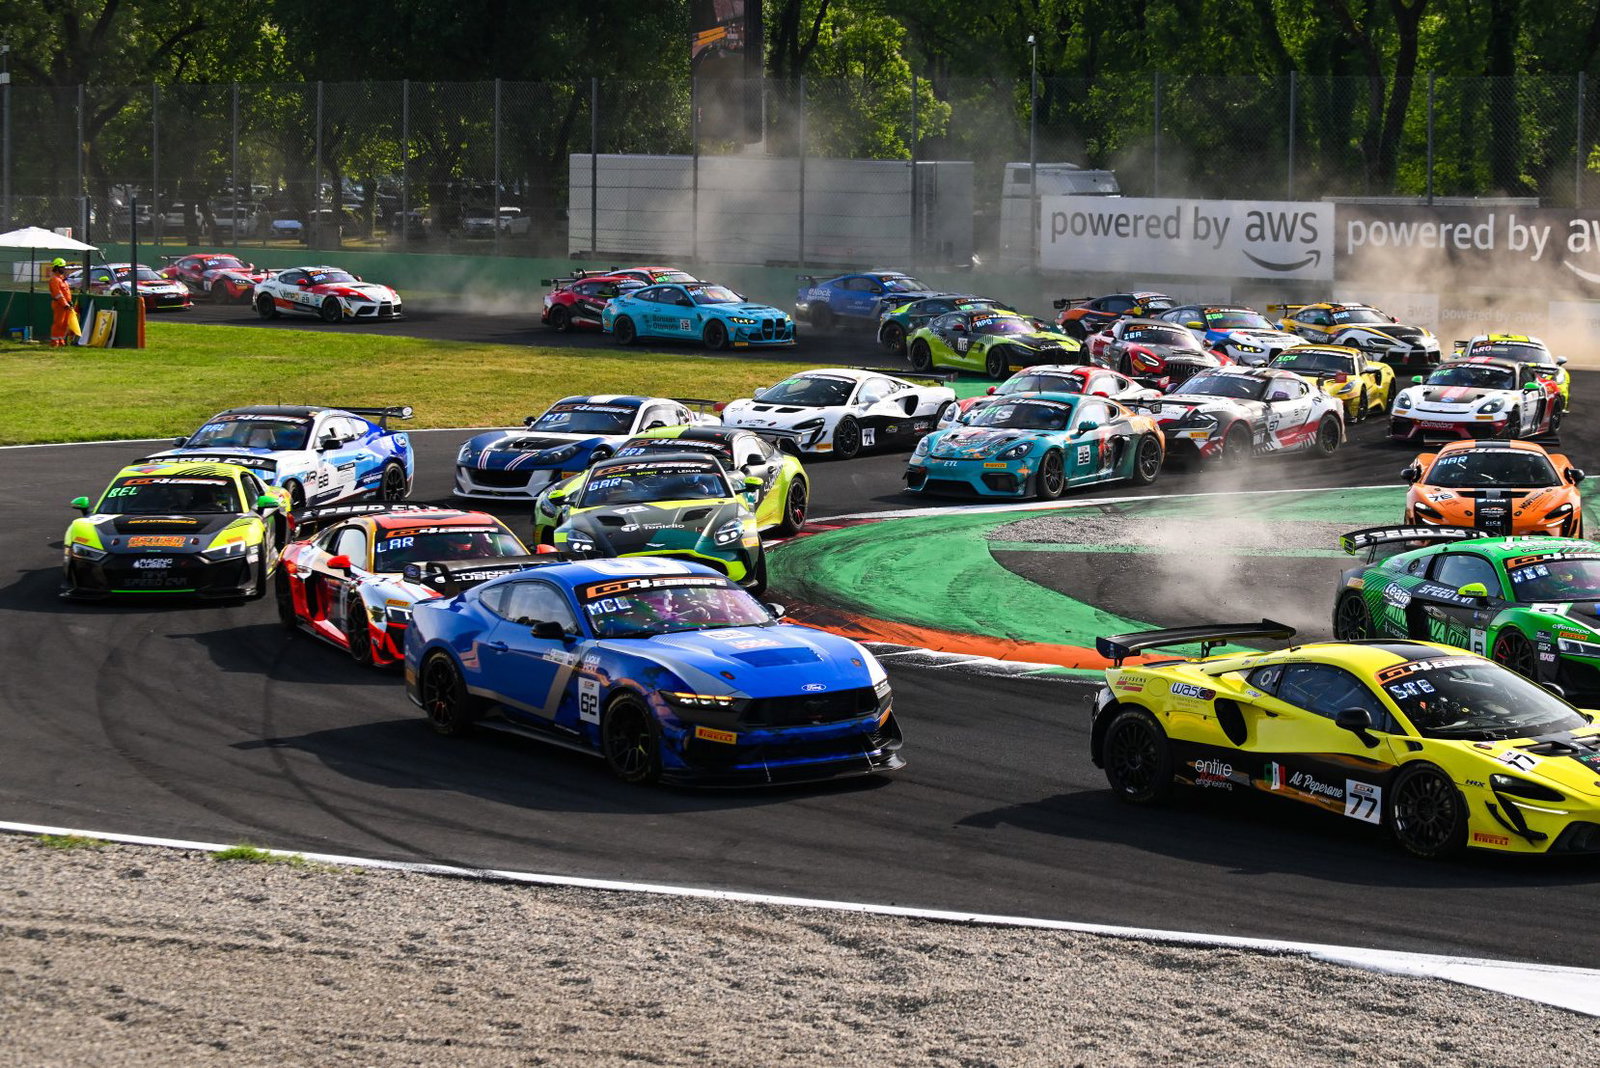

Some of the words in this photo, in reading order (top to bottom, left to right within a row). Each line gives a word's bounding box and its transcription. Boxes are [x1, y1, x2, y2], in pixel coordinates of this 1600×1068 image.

[1051, 206, 1181, 243] powered
[1193, 206, 1231, 249] by
[1245, 210, 1318, 244] aws
[1347, 213, 1495, 255] powered
[1508, 214, 1551, 261] by
[1441, 307, 1490, 321] powered
[107, 486, 138, 498] BEL
[588, 477, 622, 492] GAR
[377, 537, 414, 553] LAR
[652, 577, 728, 587] EUROPE
[1418, 584, 1456, 599] SPEED
[1384, 583, 1412, 604] team
[586, 596, 632, 616] MCL
[581, 692, 598, 716] 62
[1194, 758, 1233, 777] entire
[1195, 777, 1233, 791] engineering
[1289, 771, 1302, 785] Al
[1303, 774, 1343, 798] Peperone
[1349, 793, 1378, 819] 77
